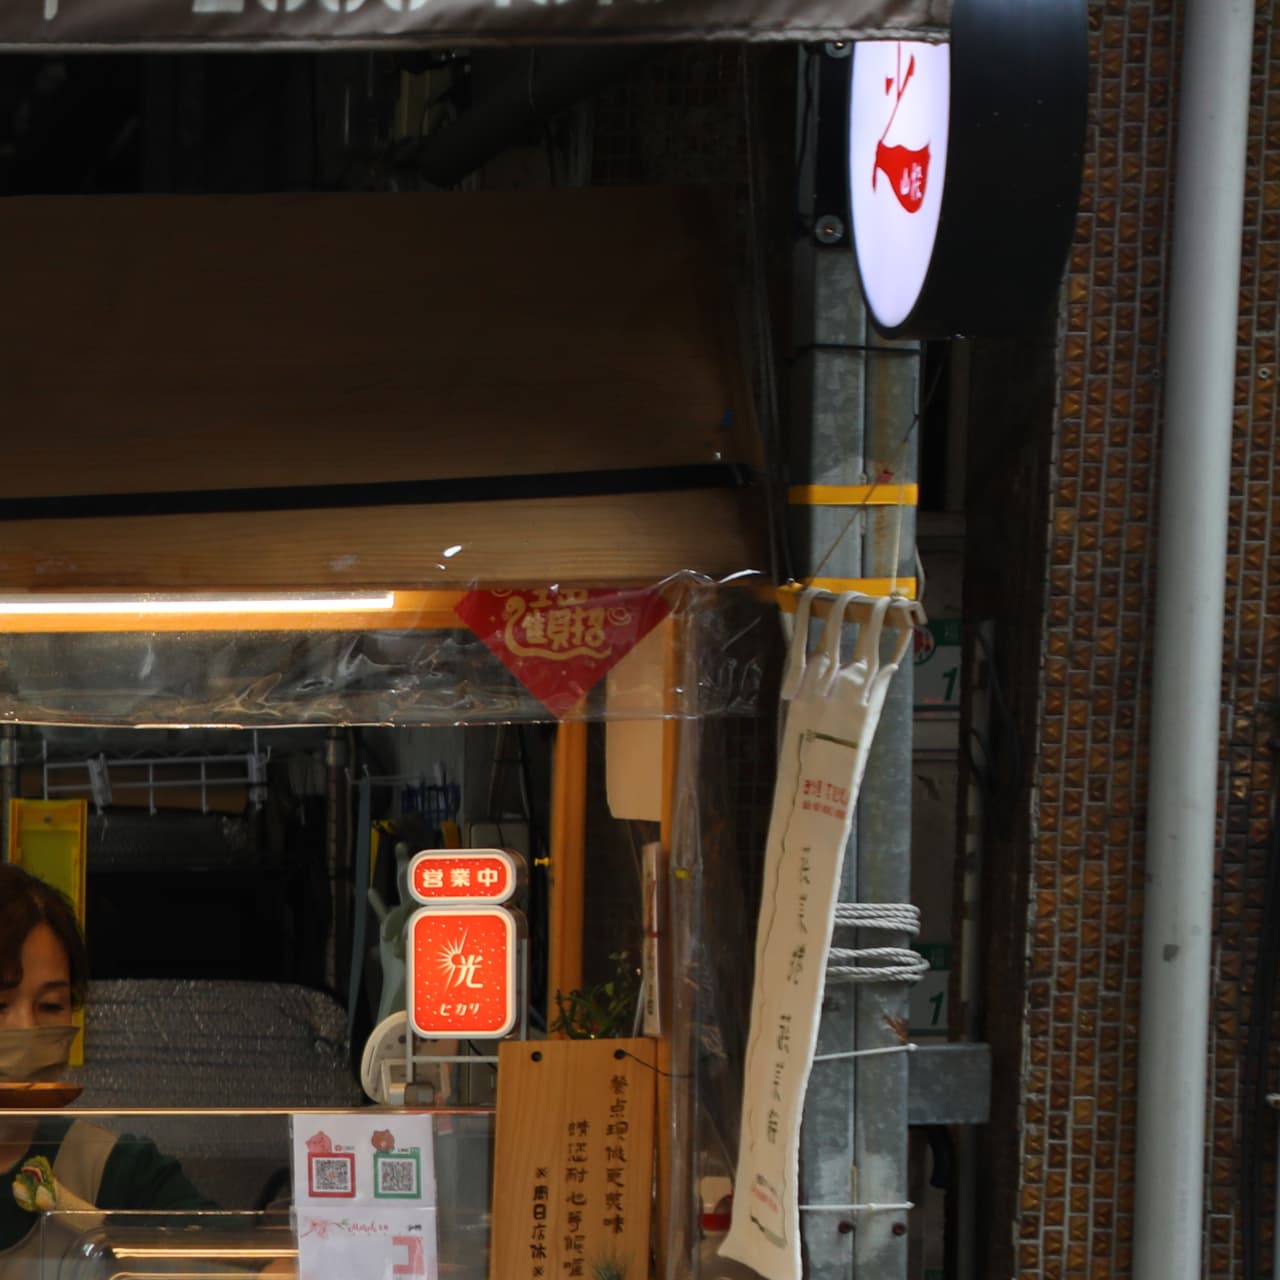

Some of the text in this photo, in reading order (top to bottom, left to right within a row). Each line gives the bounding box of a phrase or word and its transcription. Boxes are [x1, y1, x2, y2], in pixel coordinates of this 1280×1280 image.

[422, 867, 498, 889] 営業中
[440, 1002, 480, 1017] ヒカリ
